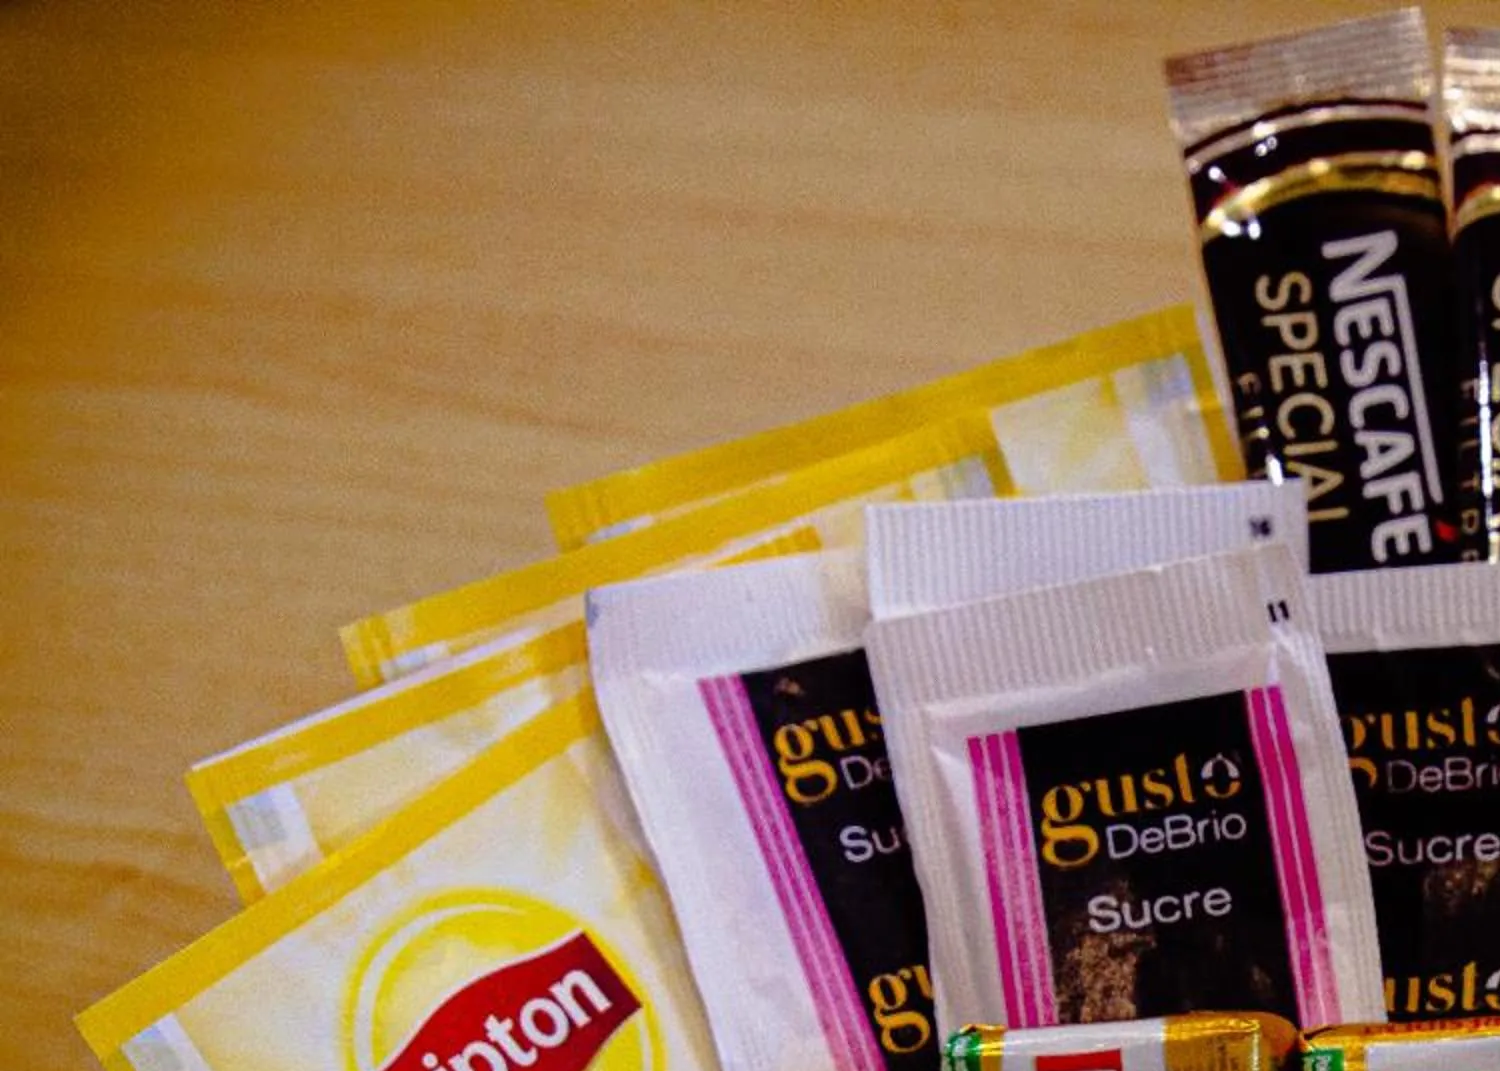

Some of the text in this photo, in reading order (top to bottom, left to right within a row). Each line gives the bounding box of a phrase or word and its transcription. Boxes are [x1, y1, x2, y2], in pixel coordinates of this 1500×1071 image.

[774, 709, 884, 807] gus
[1041, 753, 1242, 868] gusto
[1106, 812, 1247, 859] DeBrio
[1366, 831, 1500, 866] Sucre
[1088, 887, 1232, 934] Sucre
